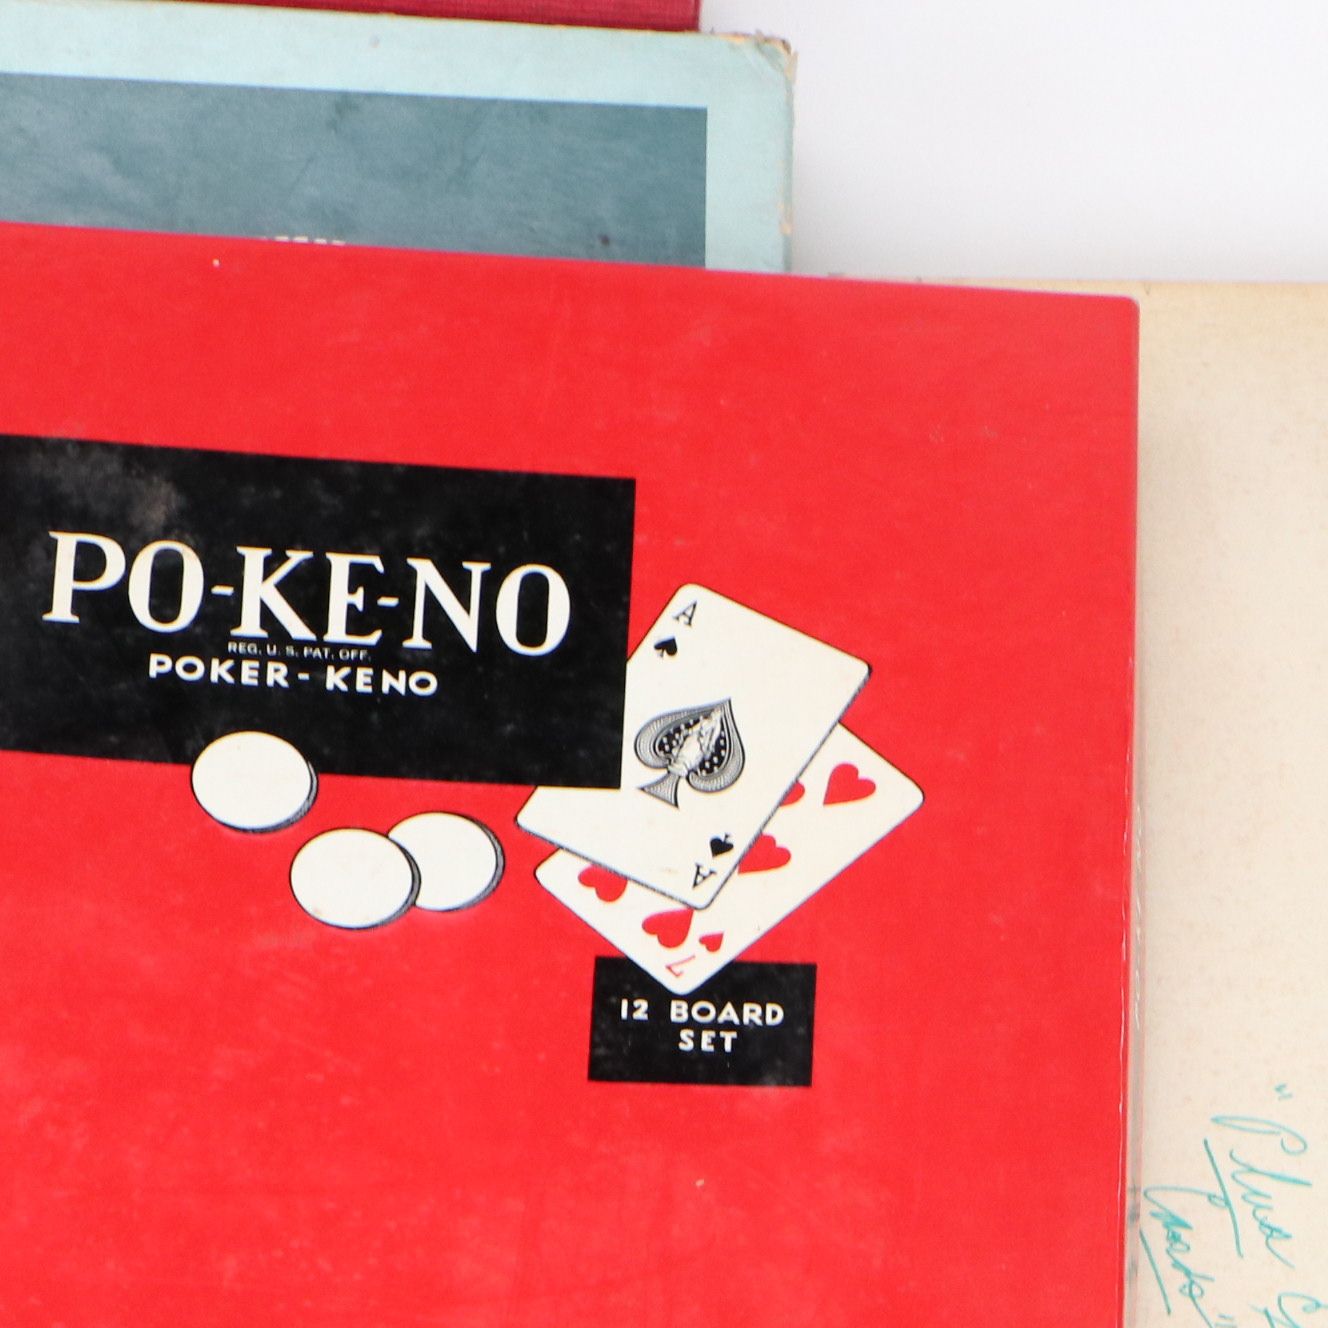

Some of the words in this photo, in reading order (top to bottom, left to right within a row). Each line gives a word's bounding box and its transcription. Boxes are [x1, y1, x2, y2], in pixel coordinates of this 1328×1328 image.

[42, 530, 571, 656] PO-KE-NO
[673, 601, 698, 627] A
[228, 642, 262, 656] REG.
[303, 646, 335, 660] PAT.
[339, 648, 372, 662] OFF.
[620, 998, 649, 1021] 12
[670, 999, 785, 1027] BOARD
[678, 1028, 738, 1053] SET
